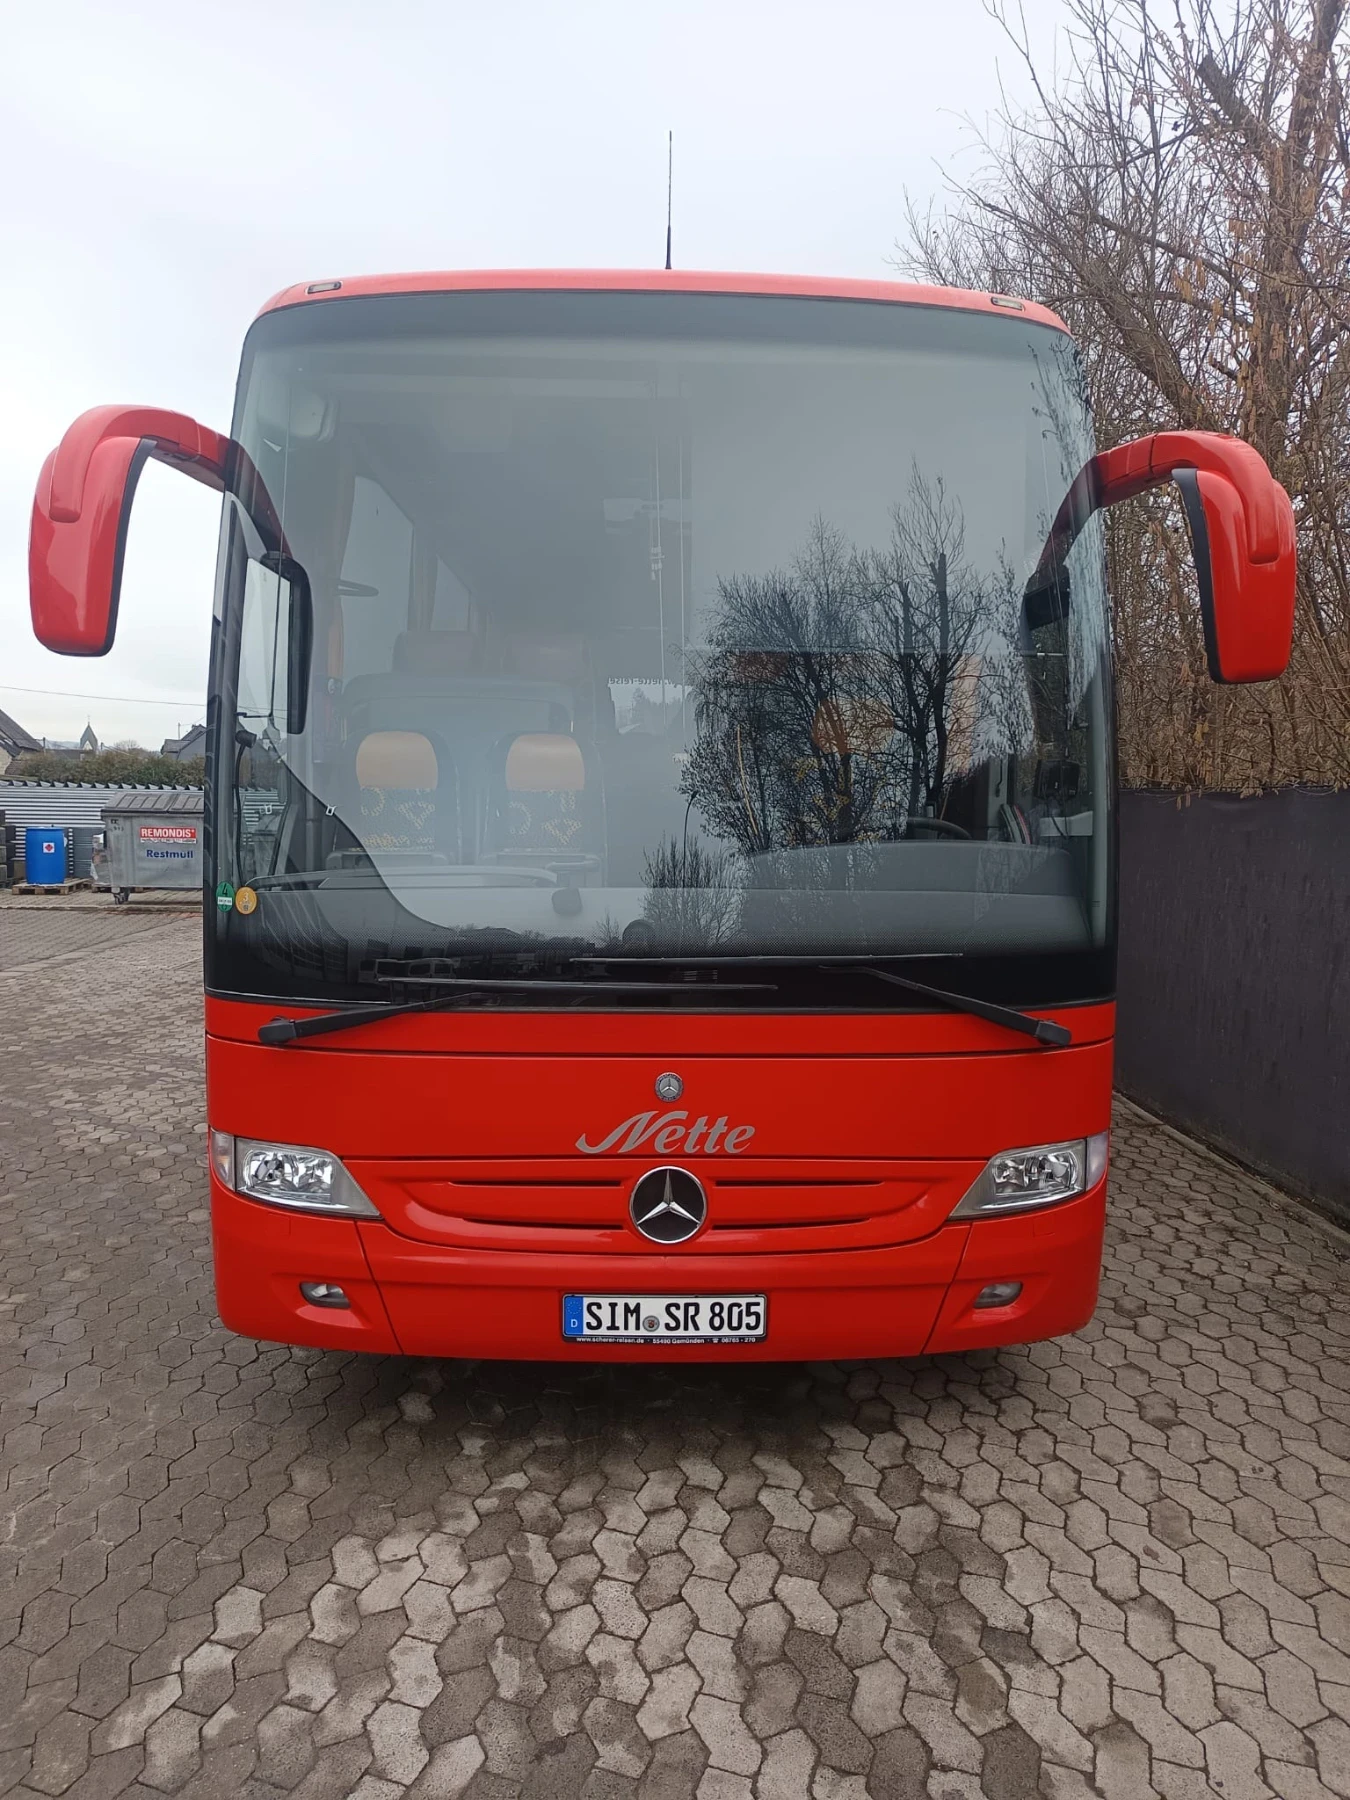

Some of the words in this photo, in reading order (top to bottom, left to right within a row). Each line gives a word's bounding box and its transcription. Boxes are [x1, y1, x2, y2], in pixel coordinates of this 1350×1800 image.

[141, 828, 192, 838] REMONDIS
[221, 883, 228, 897] 4
[575, 1110, 756, 1154] Nette
[570, 1319, 578, 1328] D
[585, 1301, 641, 1332] SIM
[664, 1301, 700, 1332] SR
[709, 1301, 761, 1332] 805
